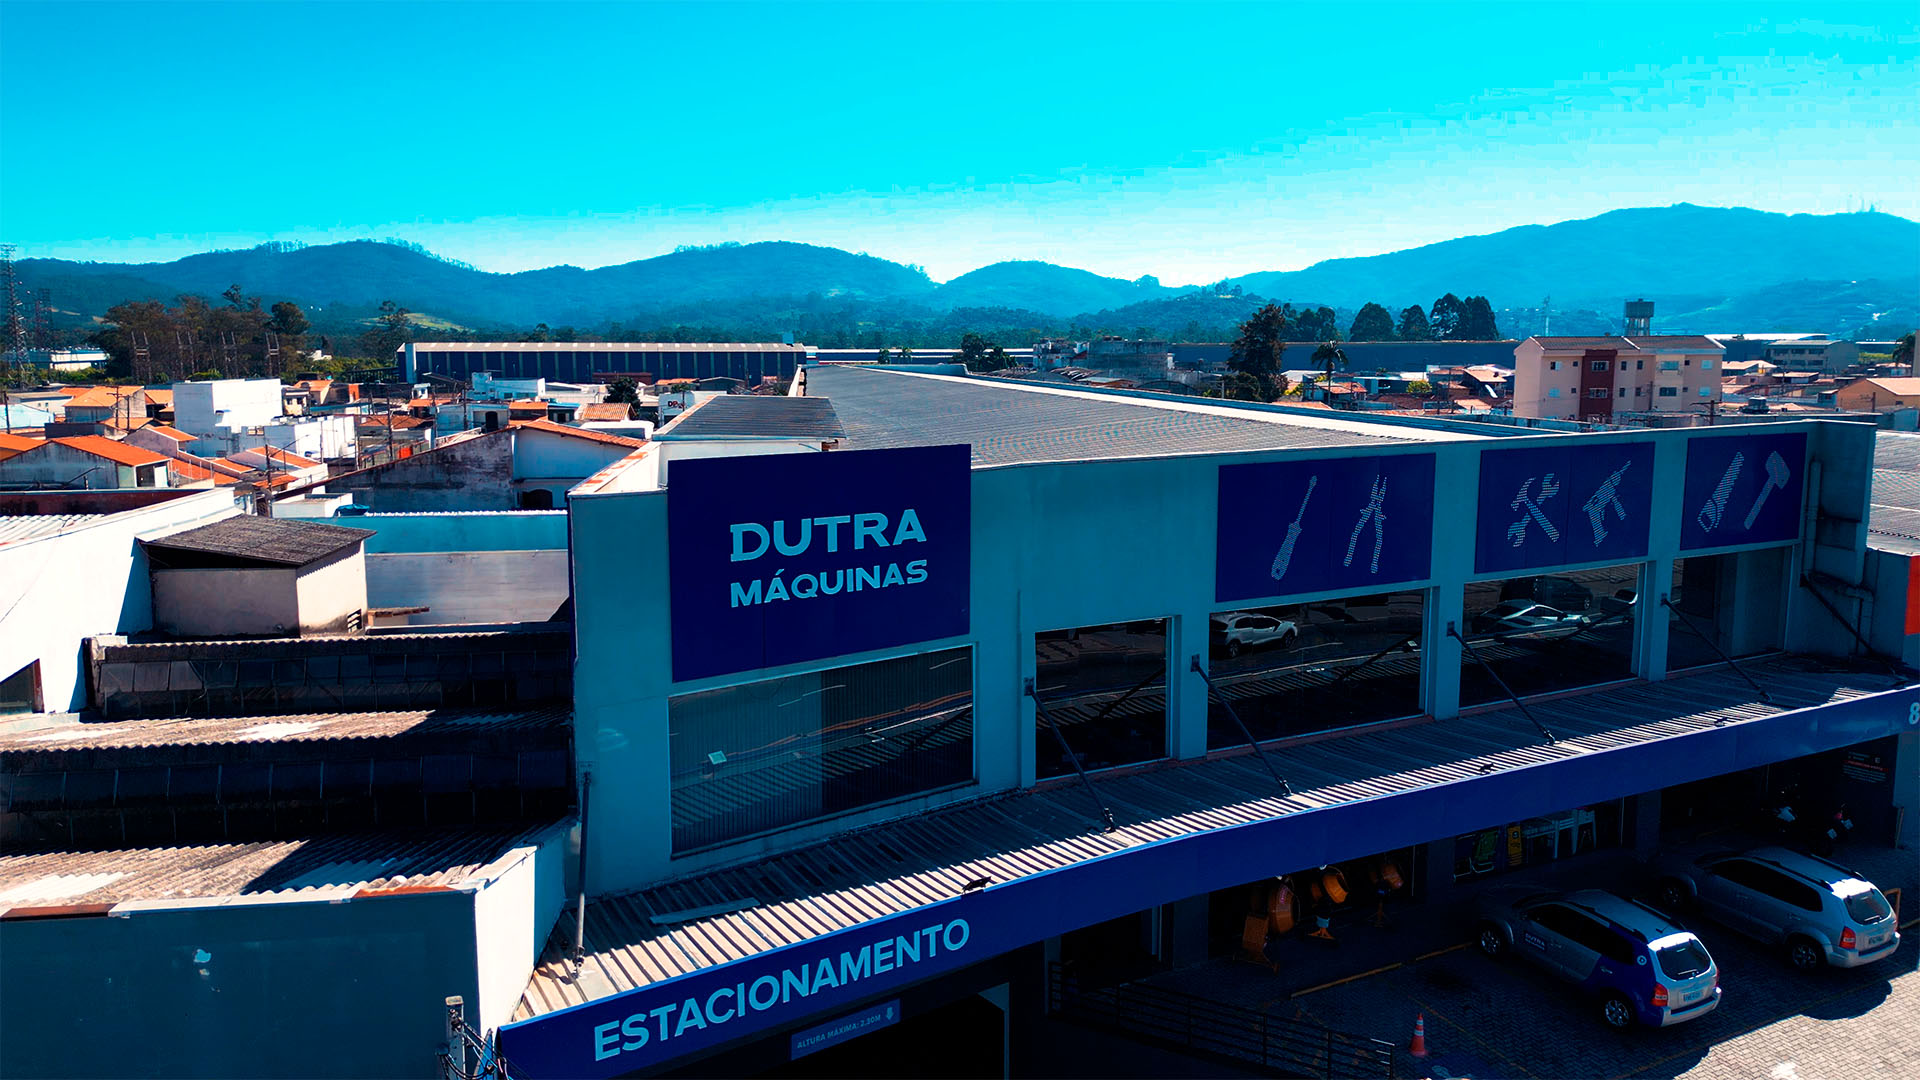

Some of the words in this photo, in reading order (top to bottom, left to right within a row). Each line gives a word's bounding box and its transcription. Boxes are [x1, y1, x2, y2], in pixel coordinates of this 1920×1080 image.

[730, 509, 927, 562] DUTRA
[730, 559, 928, 607] MÁQUINAS
[595, 918, 970, 1061] ESTACIONAMENTO
[797, 1033, 826, 1049] ALTURA
